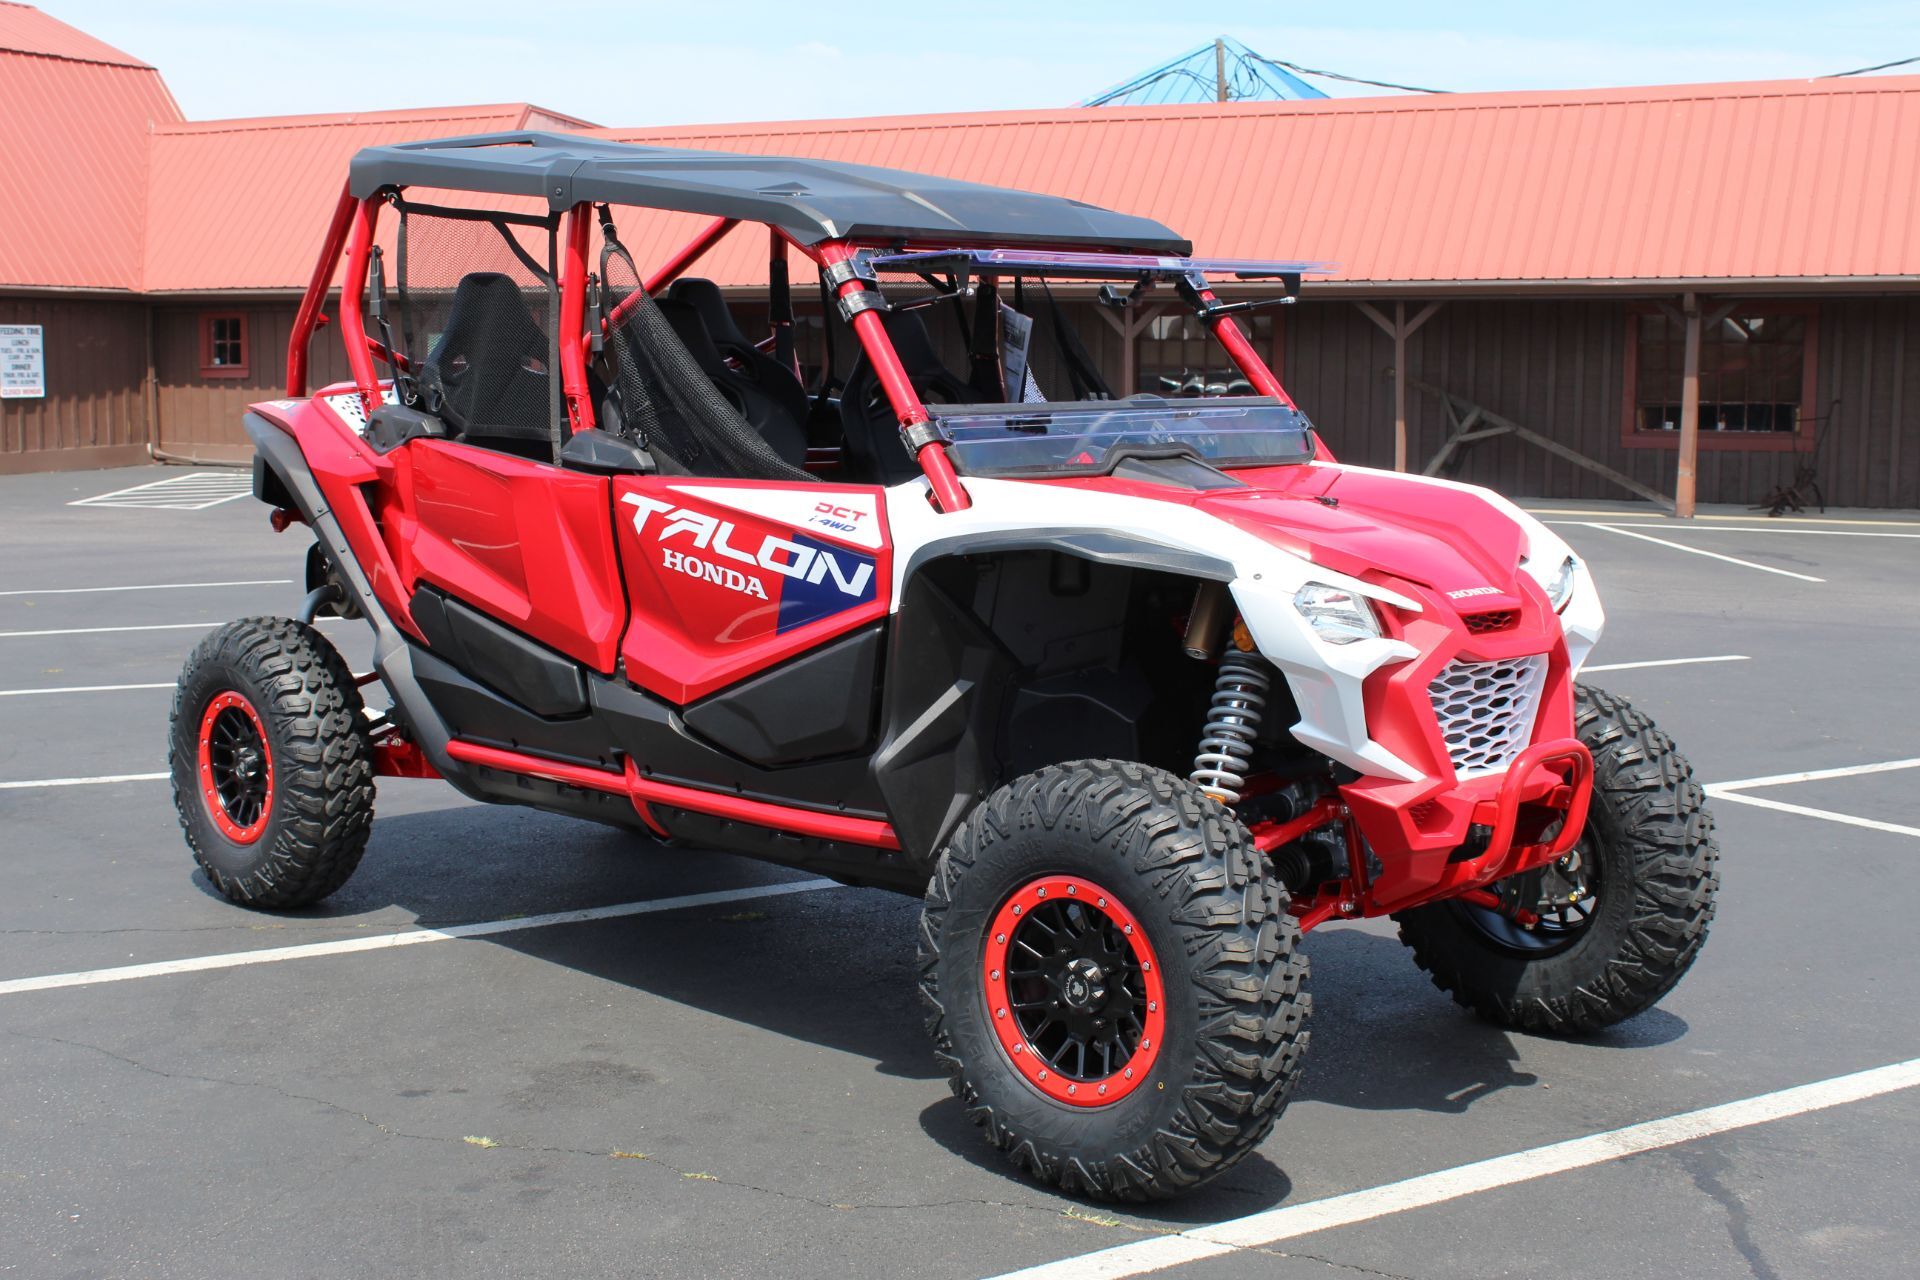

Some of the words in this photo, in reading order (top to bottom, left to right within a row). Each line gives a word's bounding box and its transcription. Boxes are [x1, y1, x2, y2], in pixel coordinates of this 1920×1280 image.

[815, 502, 867, 521] DCT
[620, 491, 874, 597] TALON
[662, 548, 769, 600] HONDA
[1445, 586, 1505, 599] HONDA
